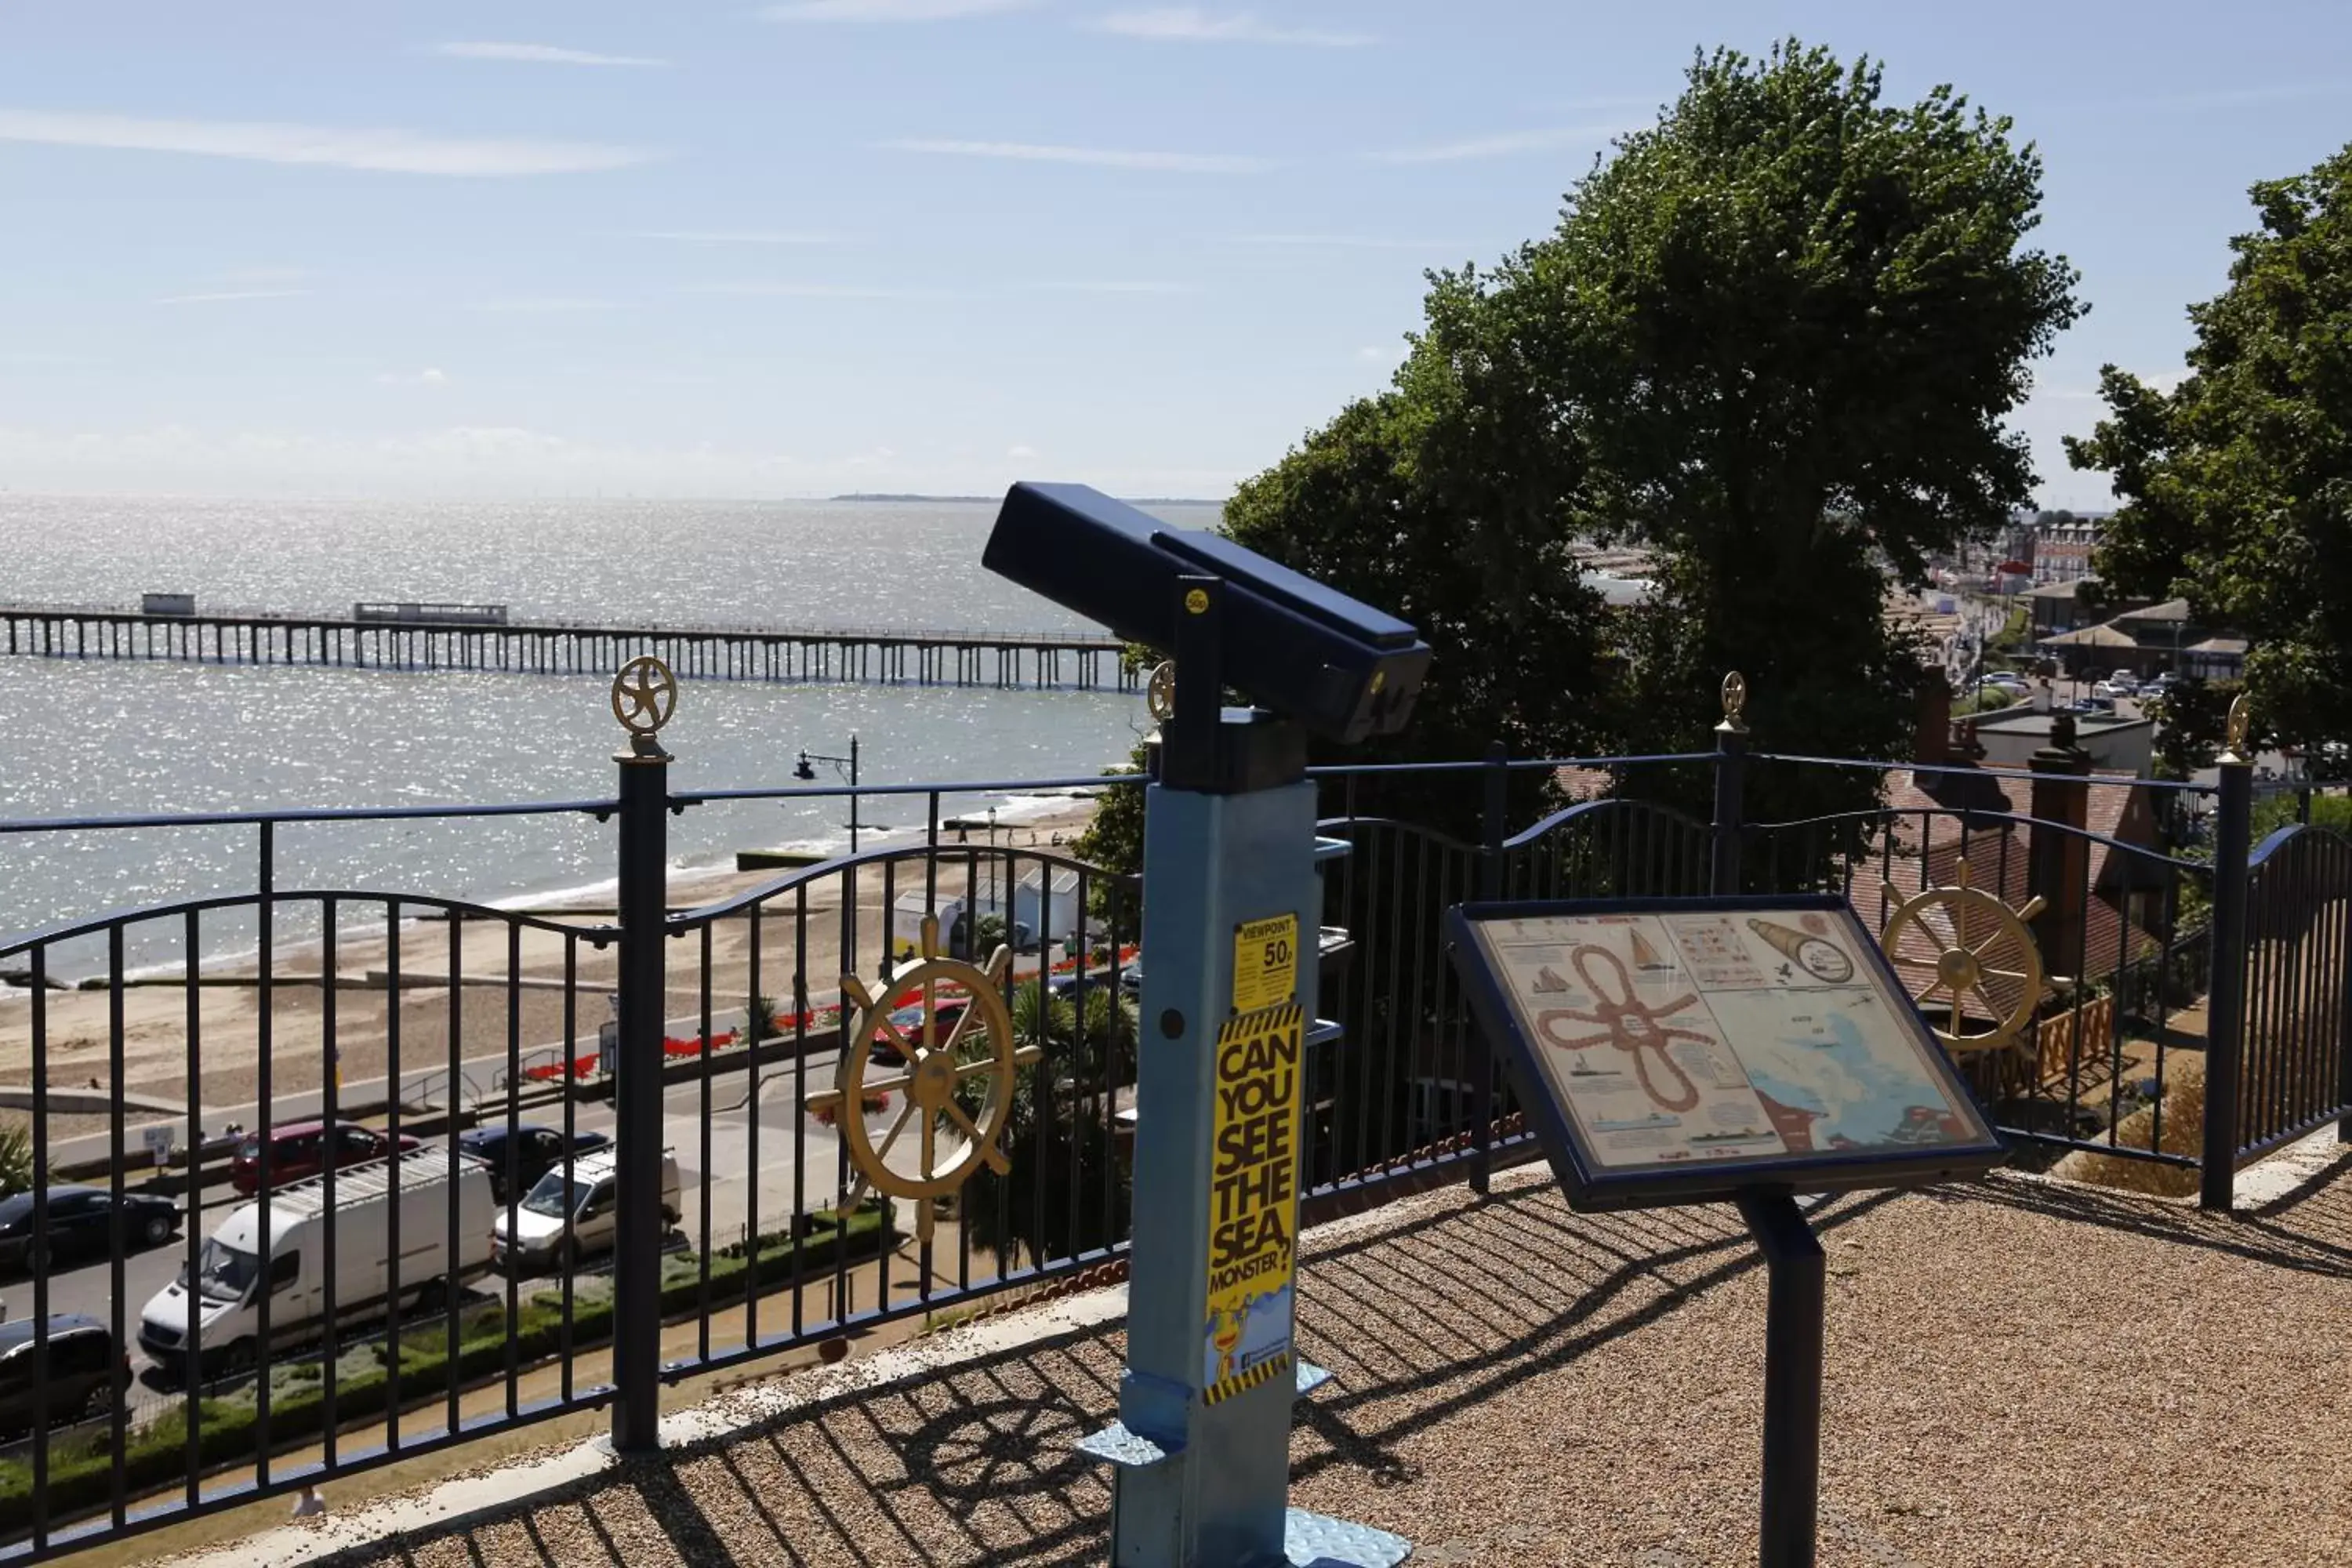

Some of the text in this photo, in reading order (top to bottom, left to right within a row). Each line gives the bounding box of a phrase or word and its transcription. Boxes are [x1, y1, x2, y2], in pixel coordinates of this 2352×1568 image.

[1219, 1029, 1298, 1082] CAN
[1219, 1069, 1292, 1121] YOU
[1216, 1108, 1290, 1175] SEE
[1214, 1157, 1292, 1223] THE
[1212, 1207, 1284, 1268] SEA
